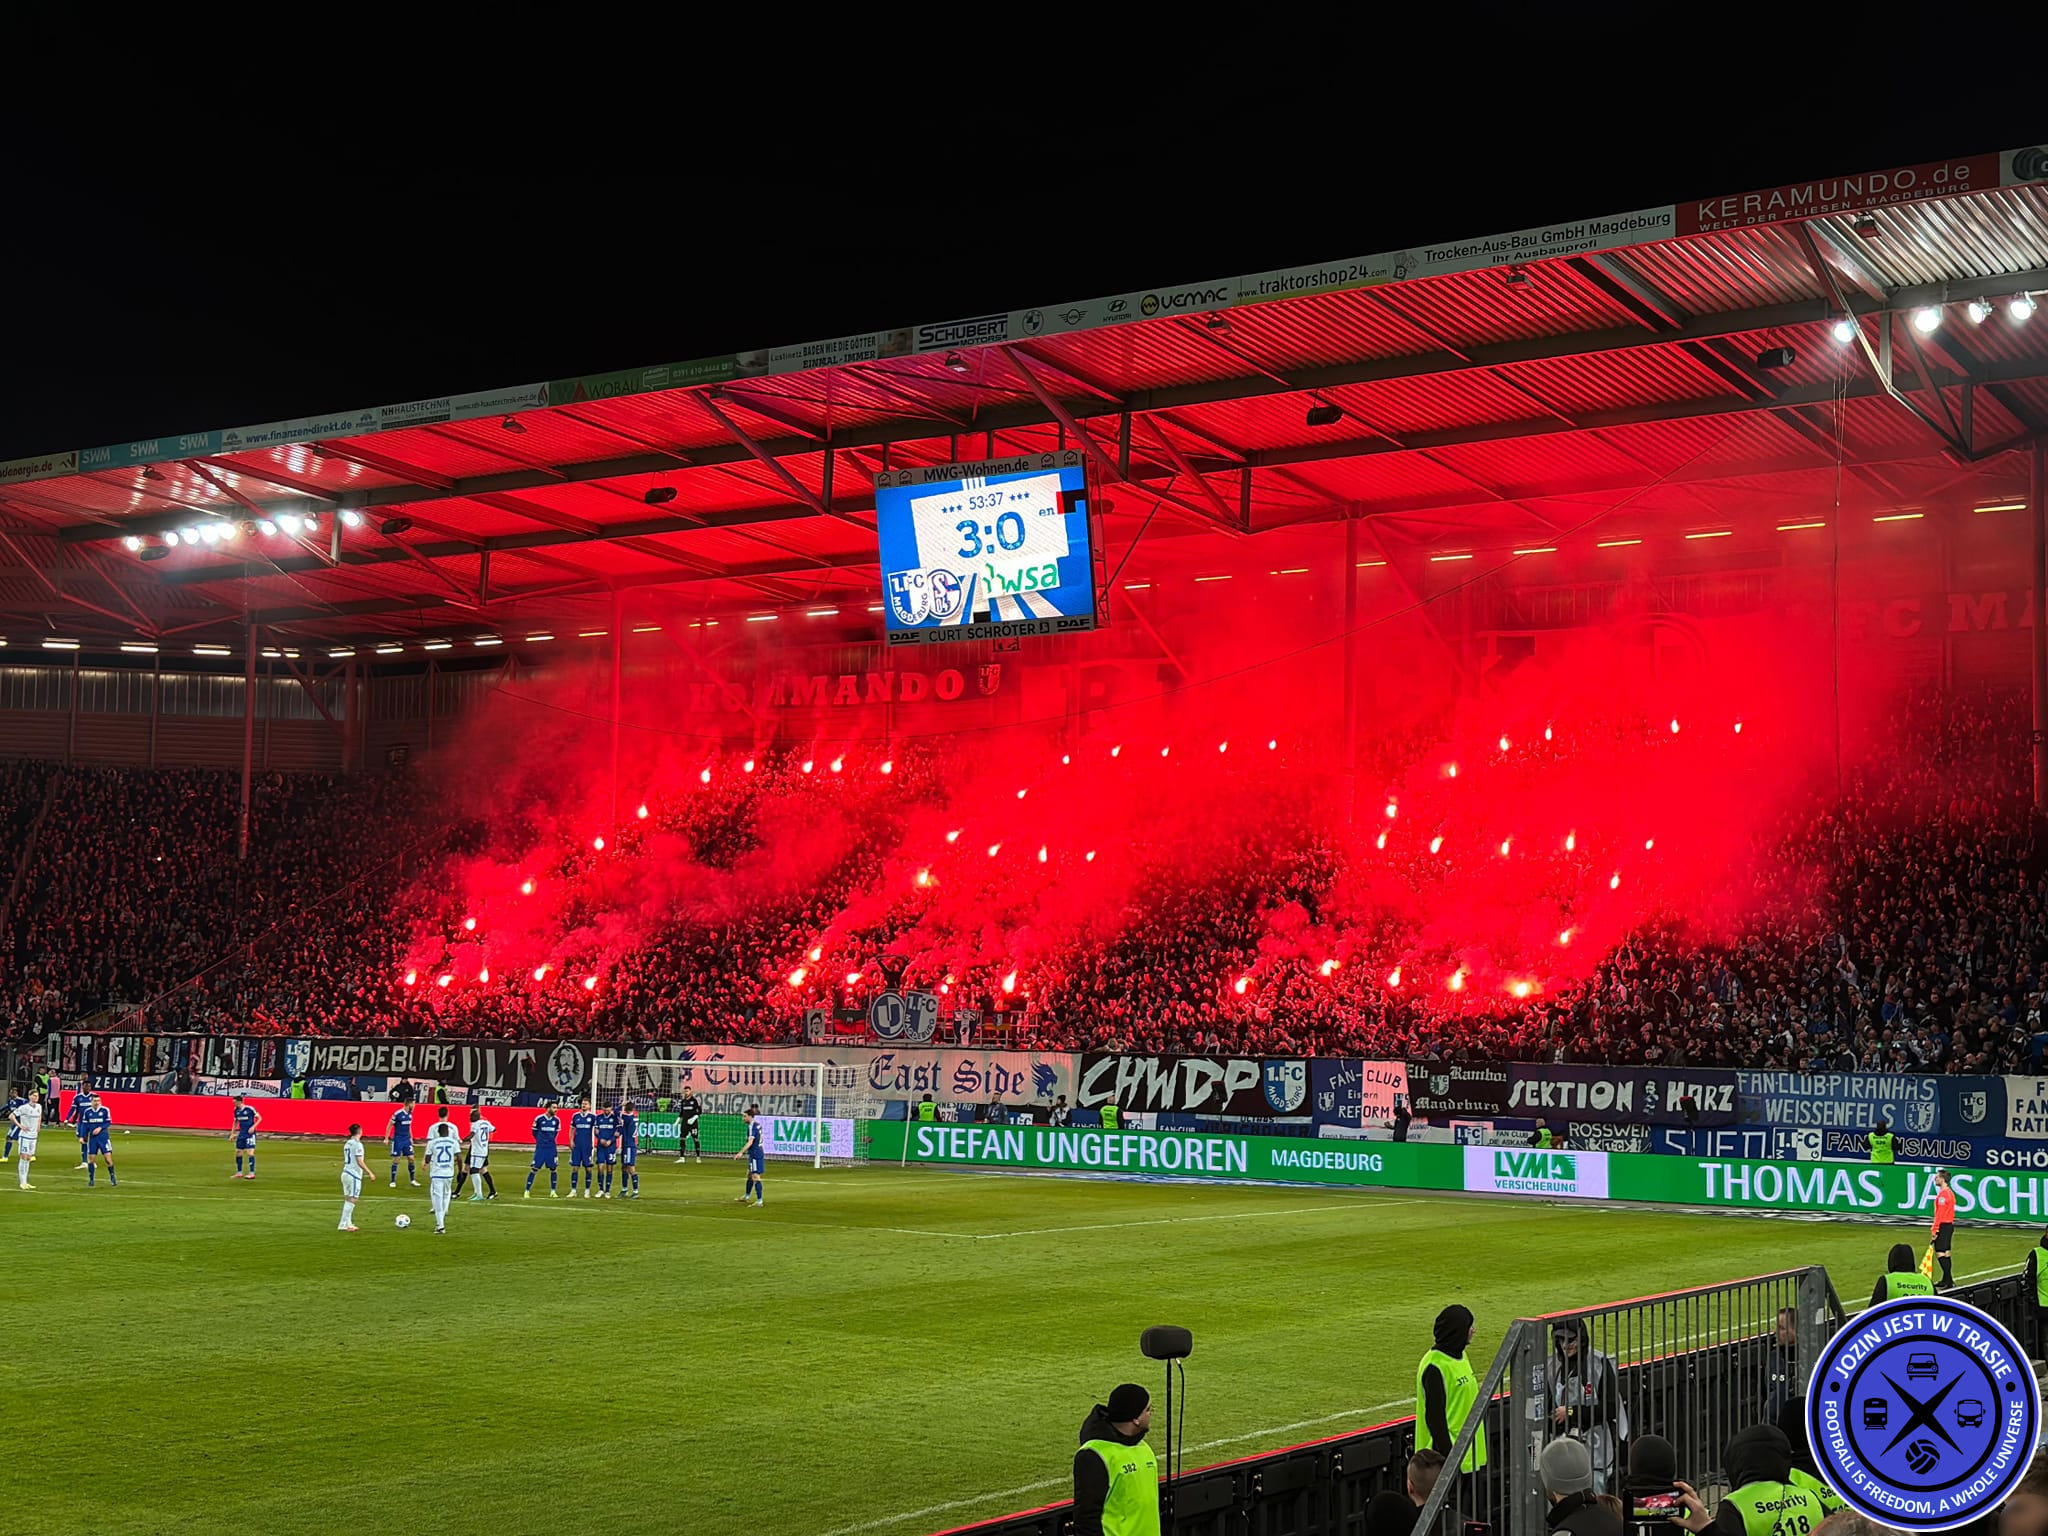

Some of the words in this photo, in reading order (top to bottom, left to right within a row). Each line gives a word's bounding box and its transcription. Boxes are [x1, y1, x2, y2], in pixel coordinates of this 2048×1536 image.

[1698, 163, 1971, 221] KERAMUNDO.de
[1699, 218, 1739, 233] WELT
[1746, 212, 1777, 225] DER
[1784, 202, 1851, 218] FLIESEN
[1866, 182, 1971, 205] MAGDEBURG
[1424, 236, 1538, 262] Trocken-Aus-Bau
[1541, 225, 1585, 244] GmbH
[1589, 211, 1671, 236] Magdeburg
[1492, 253, 1511, 264] Ihr
[1513, 239, 1597, 262] Ausbauprofi
[919, 320, 1008, 344] SCHUBERT
[959, 334, 1002, 347] MOTORS
[589, 377, 640, 399] WOBAU
[130, 440, 159, 457] SWM
[179, 433, 209, 450] SWM
[82, 448, 111, 464] SWM
[924, 458, 1029, 482] MWG-Wohnen.de
[969, 492, 1004, 510] 53:37
[956, 511, 1026, 559] 3:0
[929, 629, 962, 642] CURT
[967, 620, 1036, 640] SCHRÖTER
[1057, 618, 1091, 628] DAF
[889, 632, 920, 641] DAF
[689, 669, 965, 713] KOMMANDO
[312, 1044, 457, 1073] MAGDEBURG
[94, 1077, 137, 1089] ZEITZ
[868, 1053, 943, 1092] East
[952, 1059, 1025, 1096] Side
[1078, 1056, 1261, 1112] CHWDP
[1266, 1066, 1304, 1082] 1.FC
[1415, 1097, 1500, 1113] Magdeburg
[1507, 1079, 1634, 1112] SEKTION
[1338, 1105, 1390, 1119] REFORM
[1765, 1098, 1896, 1129] WEISSENFELS
[917, 1126, 1023, 1161] STEFAN
[1037, 1132, 1247, 1172] UNGEFROREN
[1271, 1149, 1383, 1172] MAGDEBURG
[1494, 1151, 1548, 1179] LVM
[1494, 1179, 1576, 1193] VERSICHERUNG
[1698, 1162, 1883, 1208] THOMAS
[1896, 1281, 1928, 1292] Security
[1122, 1463, 1137, 1474] 382
[1754, 1493, 1808, 1515] Security
